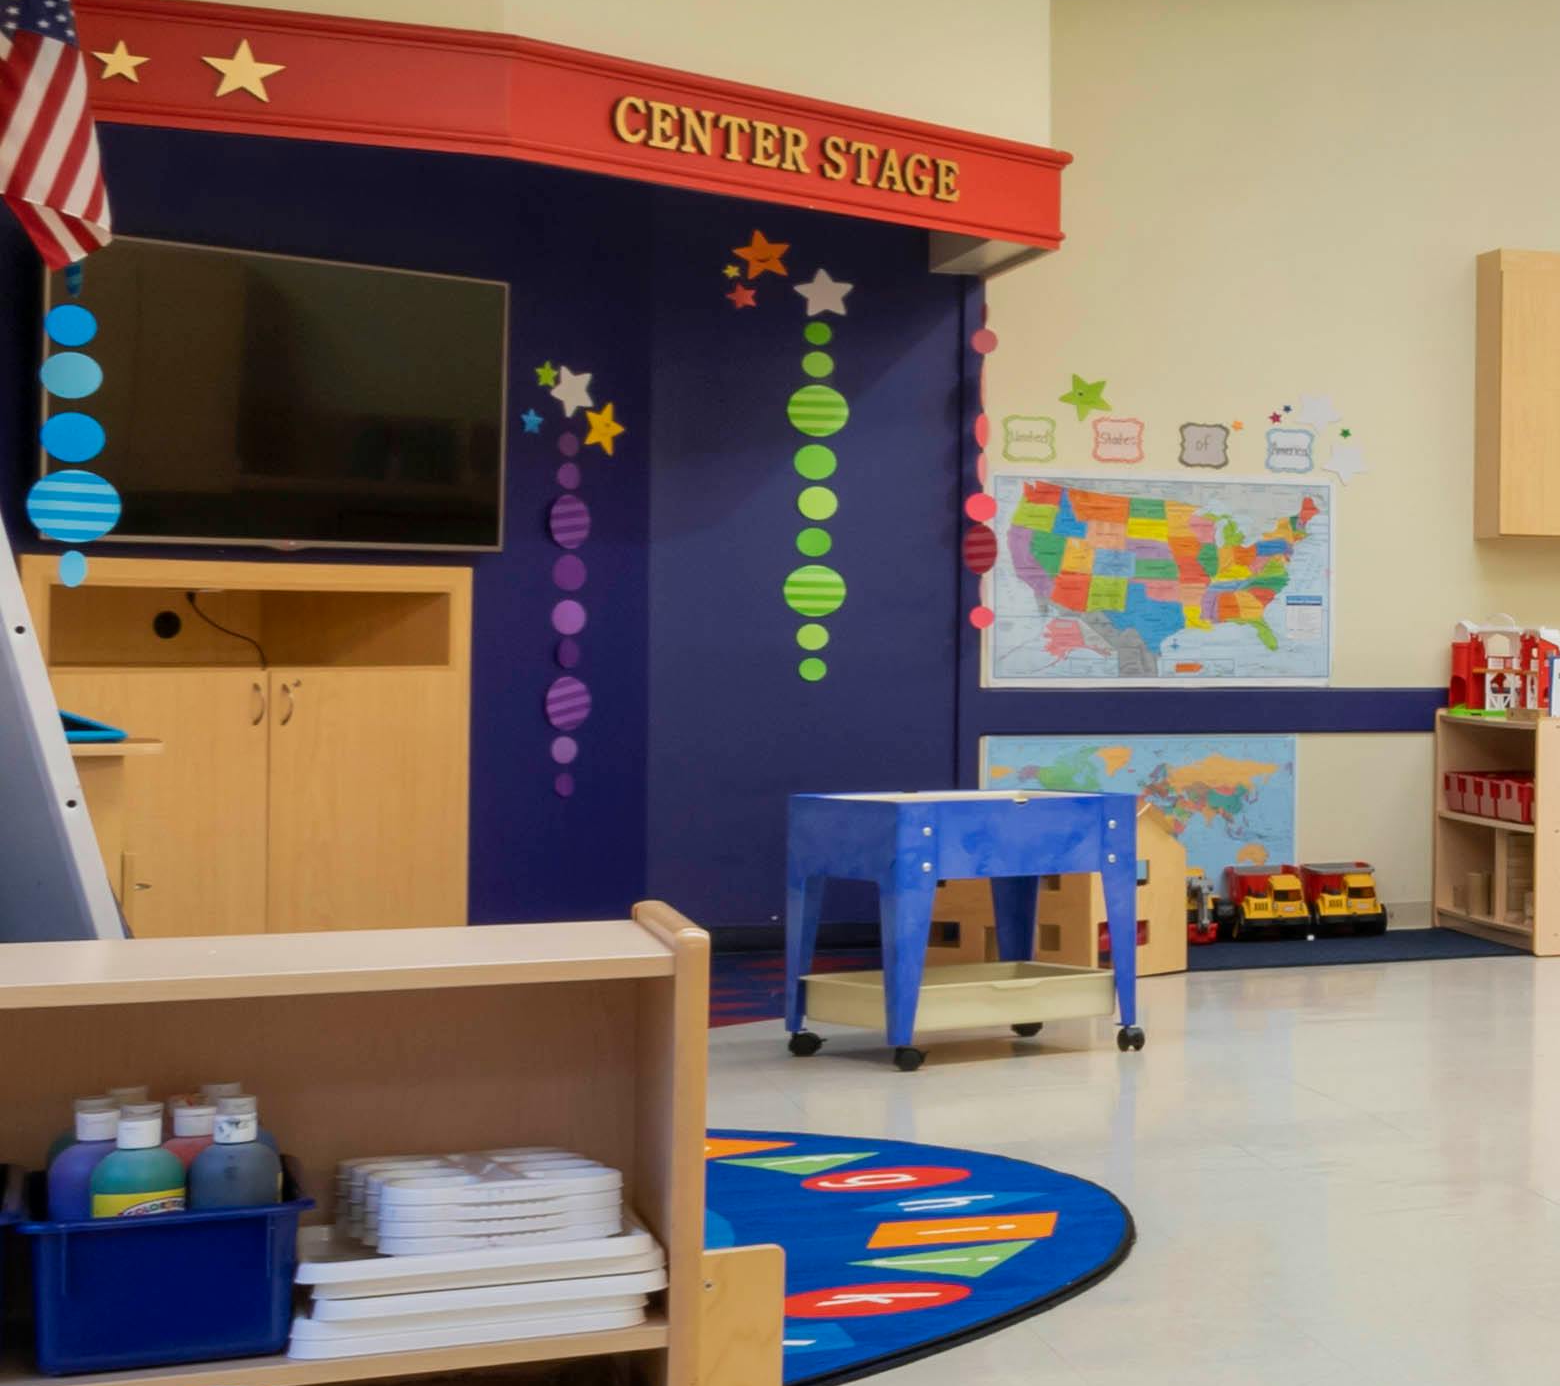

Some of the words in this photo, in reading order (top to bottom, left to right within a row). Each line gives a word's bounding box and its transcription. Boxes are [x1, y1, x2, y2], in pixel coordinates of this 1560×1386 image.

[613, 95, 812, 173] CENTER
[821, 134, 962, 203] STAGE
[1195, 436, 1211, 451] of
